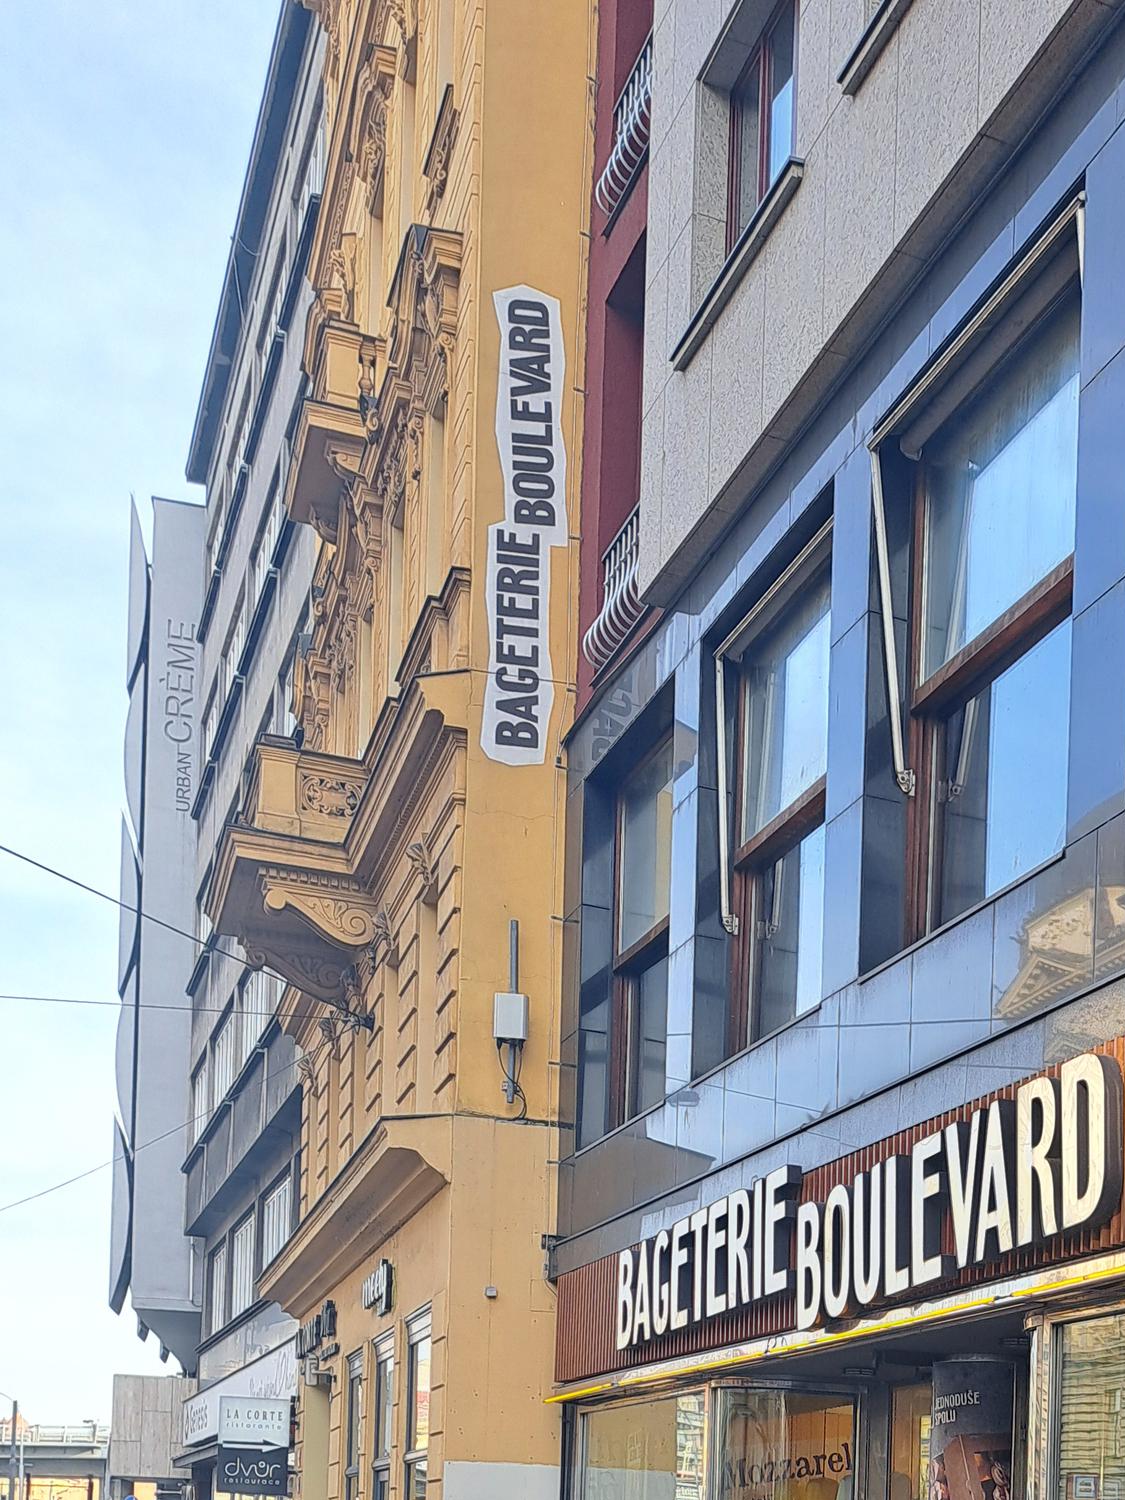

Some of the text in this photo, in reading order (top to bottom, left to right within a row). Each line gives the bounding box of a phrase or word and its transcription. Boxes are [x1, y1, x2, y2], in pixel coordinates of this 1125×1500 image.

[495, 299, 556, 750] BAGETERIE BOULEVARD
[159, 617, 196, 813] URBAN CRÈME
[616, 1053, 1112, 1352] BAGETERIE BOULEVARD
[934, 1390, 980, 1410] JEDNODUŠE
[226, 1408, 283, 1421] LA CORTE
[934, 1409, 956, 1426] SPOLU
[226, 1422, 282, 1430] ristorante
[224, 1477, 280, 1485] restaurace
